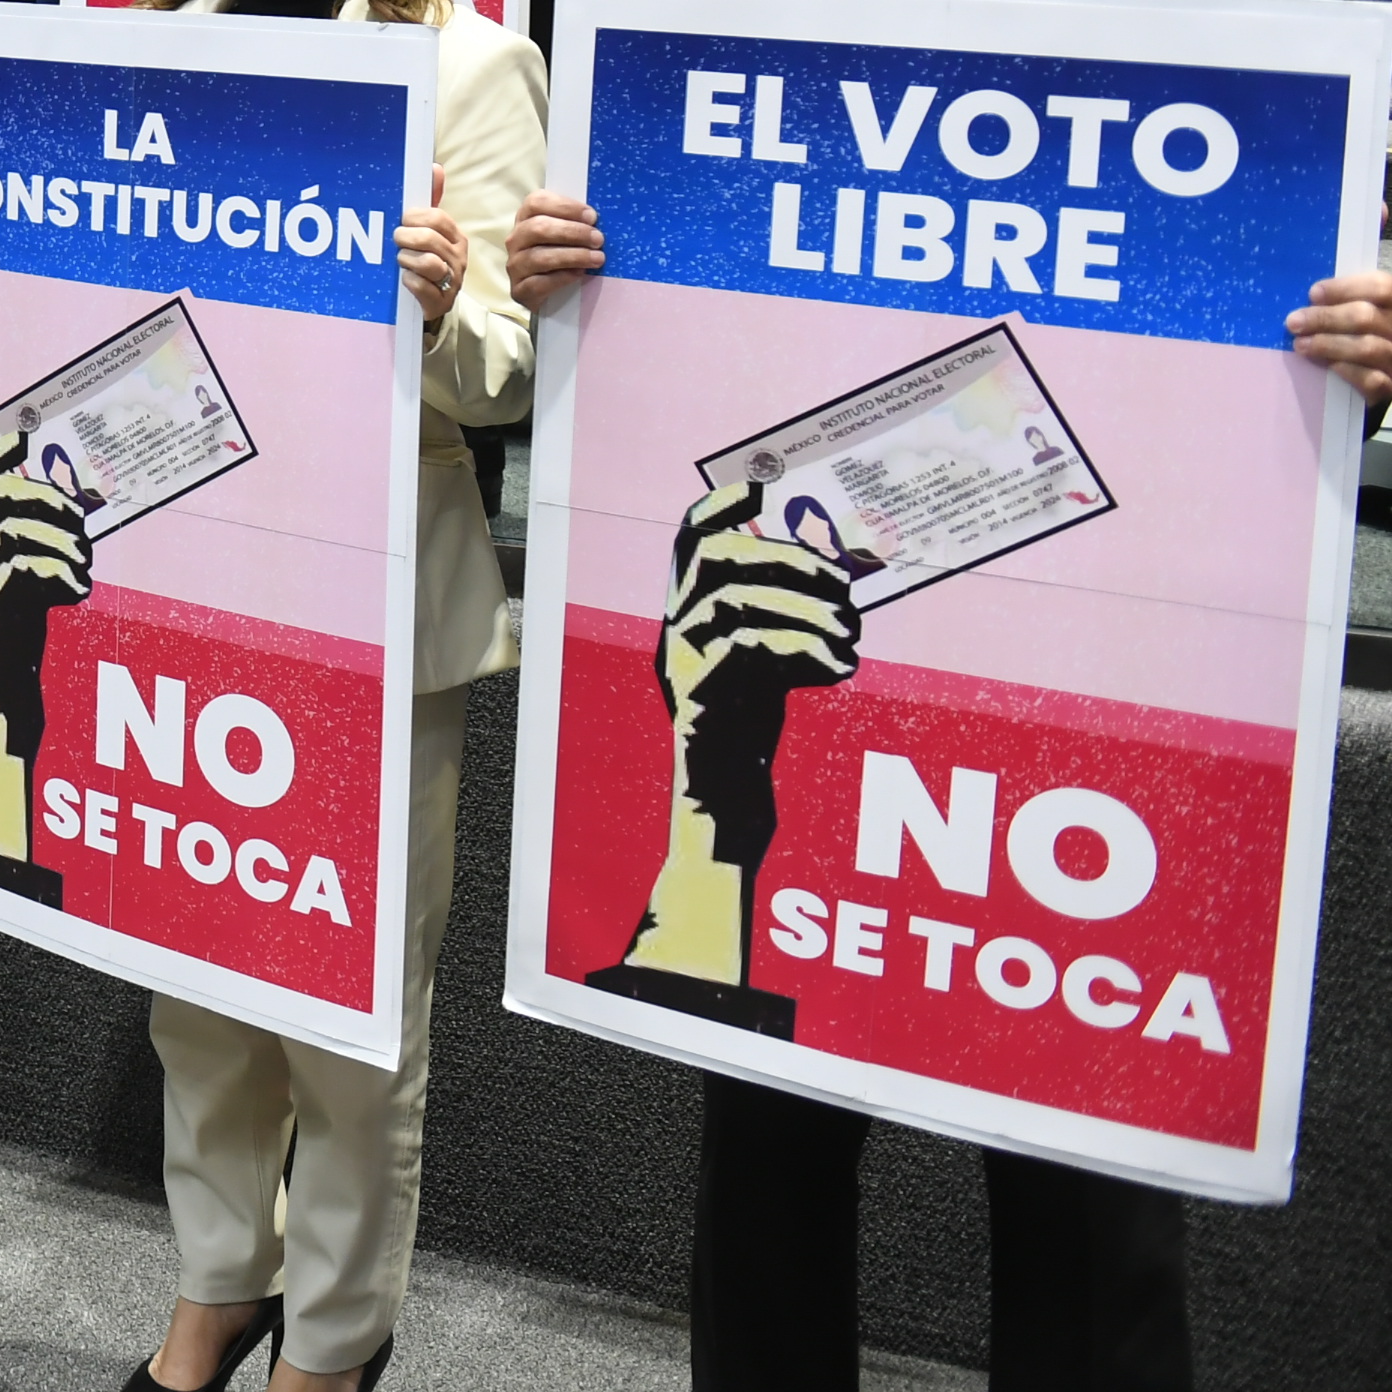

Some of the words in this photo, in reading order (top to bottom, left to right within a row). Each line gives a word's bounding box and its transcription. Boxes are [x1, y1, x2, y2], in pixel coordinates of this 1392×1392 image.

[104, 110, 175, 164] LA
[684, 71, 807, 163] EL
[840, 81, 1239, 196] VOTO
[768, 183, 1125, 303] LIBRE
[784, 434, 822, 456] MÉXICO
[819, 398, 875, 431] INSTITUTO
[875, 374, 933, 407] NACIONAL
[932, 344, 996, 380] ELECTORAL
[828, 409, 886, 442] CREDENCIAL
[886, 398, 912, 416] PARA
[911, 384, 945, 404] VOTAR
[96, 658, 295, 810] NO
[44, 778, 118, 854] SE
[130, 806, 352, 926] TOCA
[853, 751, 1157, 920] NO
[770, 888, 888, 976] SE
[909, 901, 1230, 1053] TOCA
